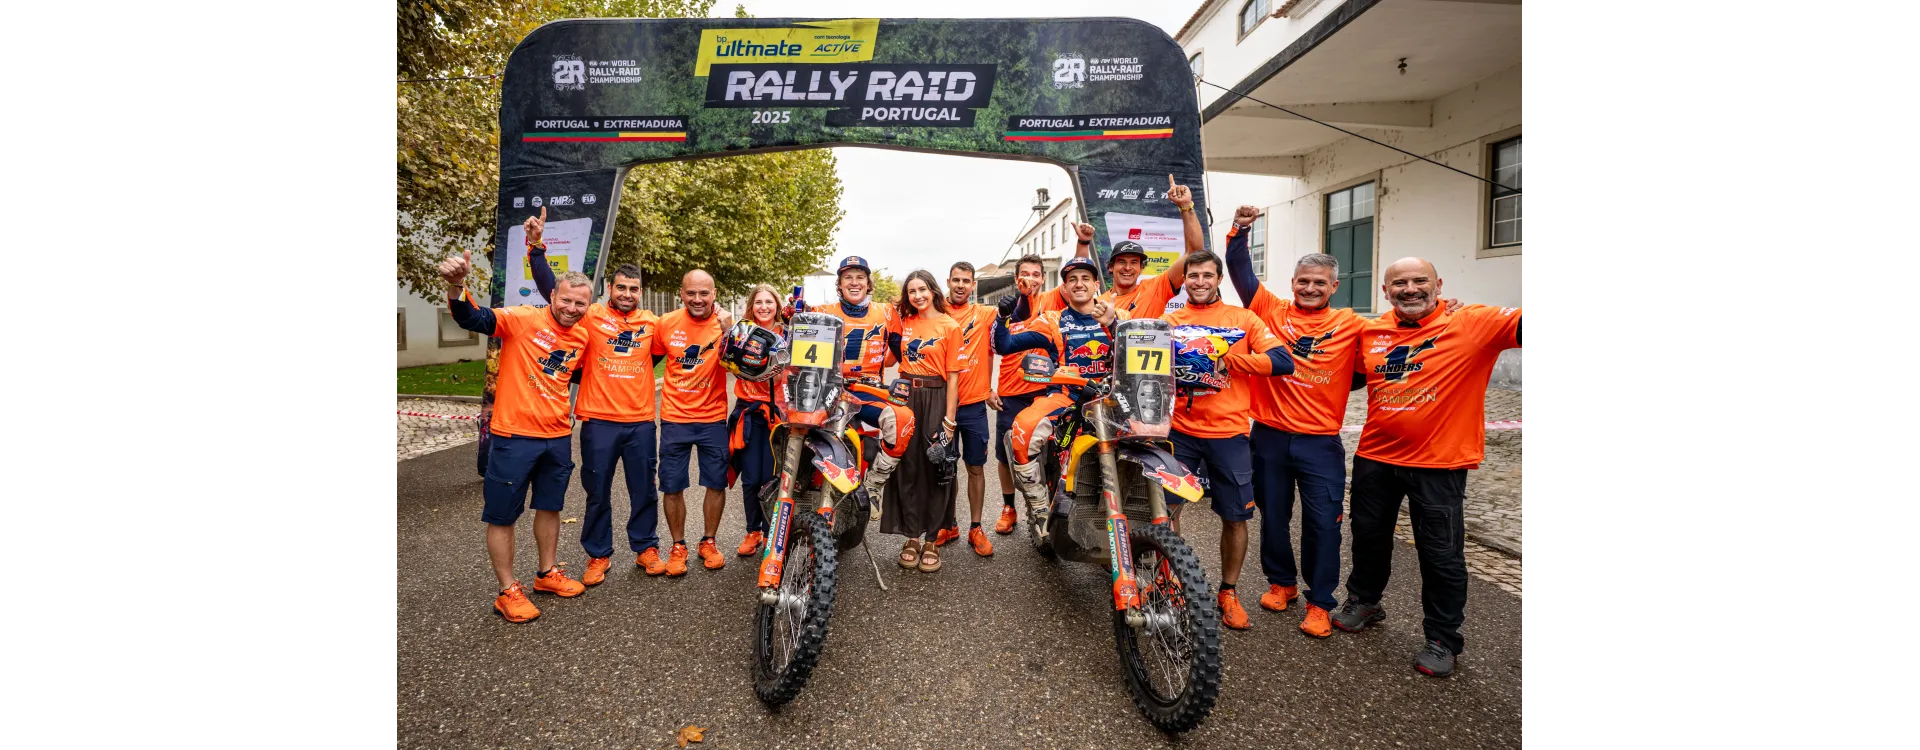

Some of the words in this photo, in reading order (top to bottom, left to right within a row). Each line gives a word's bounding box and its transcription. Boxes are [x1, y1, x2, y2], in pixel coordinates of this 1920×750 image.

[717, 35, 727, 44] bp
[716, 39, 802, 56] ultimate
[814, 44, 861, 52] ACTIVE
[589, 67, 641, 76] RALLY-RAID
[1090, 65, 1142, 74] RALLY-RAID
[725, 70, 857, 101] RALLY
[865, 70, 976, 101] RAID
[752, 110, 790, 124] 2025
[861, 107, 961, 121] PORTUGAL
[535, 119, 590, 129] PORTUGAL
[603, 119, 683, 129] EXTREMADURA
[1019, 119, 1075, 128] PORTUGAL
[1089, 116, 1171, 127] EXTREMADURA
[1097, 189, 1119, 199] FIM
[606, 338, 642, 348] SANDERS
[676, 356, 705, 365] SANDER
[805, 344, 817, 363] 4
[1137, 350, 1163, 371] 77
[537, 356, 570, 373] SANDERS
[598, 362, 644, 374] CHAMPION
[1374, 362, 1424, 373] SANDERS
[1292, 369, 1331, 384] MPION
[1115, 392, 1131, 413] KTM
[766, 513, 778, 550] MOTOREX
[777, 505, 789, 546] MICHELIN
[1118, 522, 1130, 566] MICHELIN
[1108, 532, 1119, 573] MOTOREX
